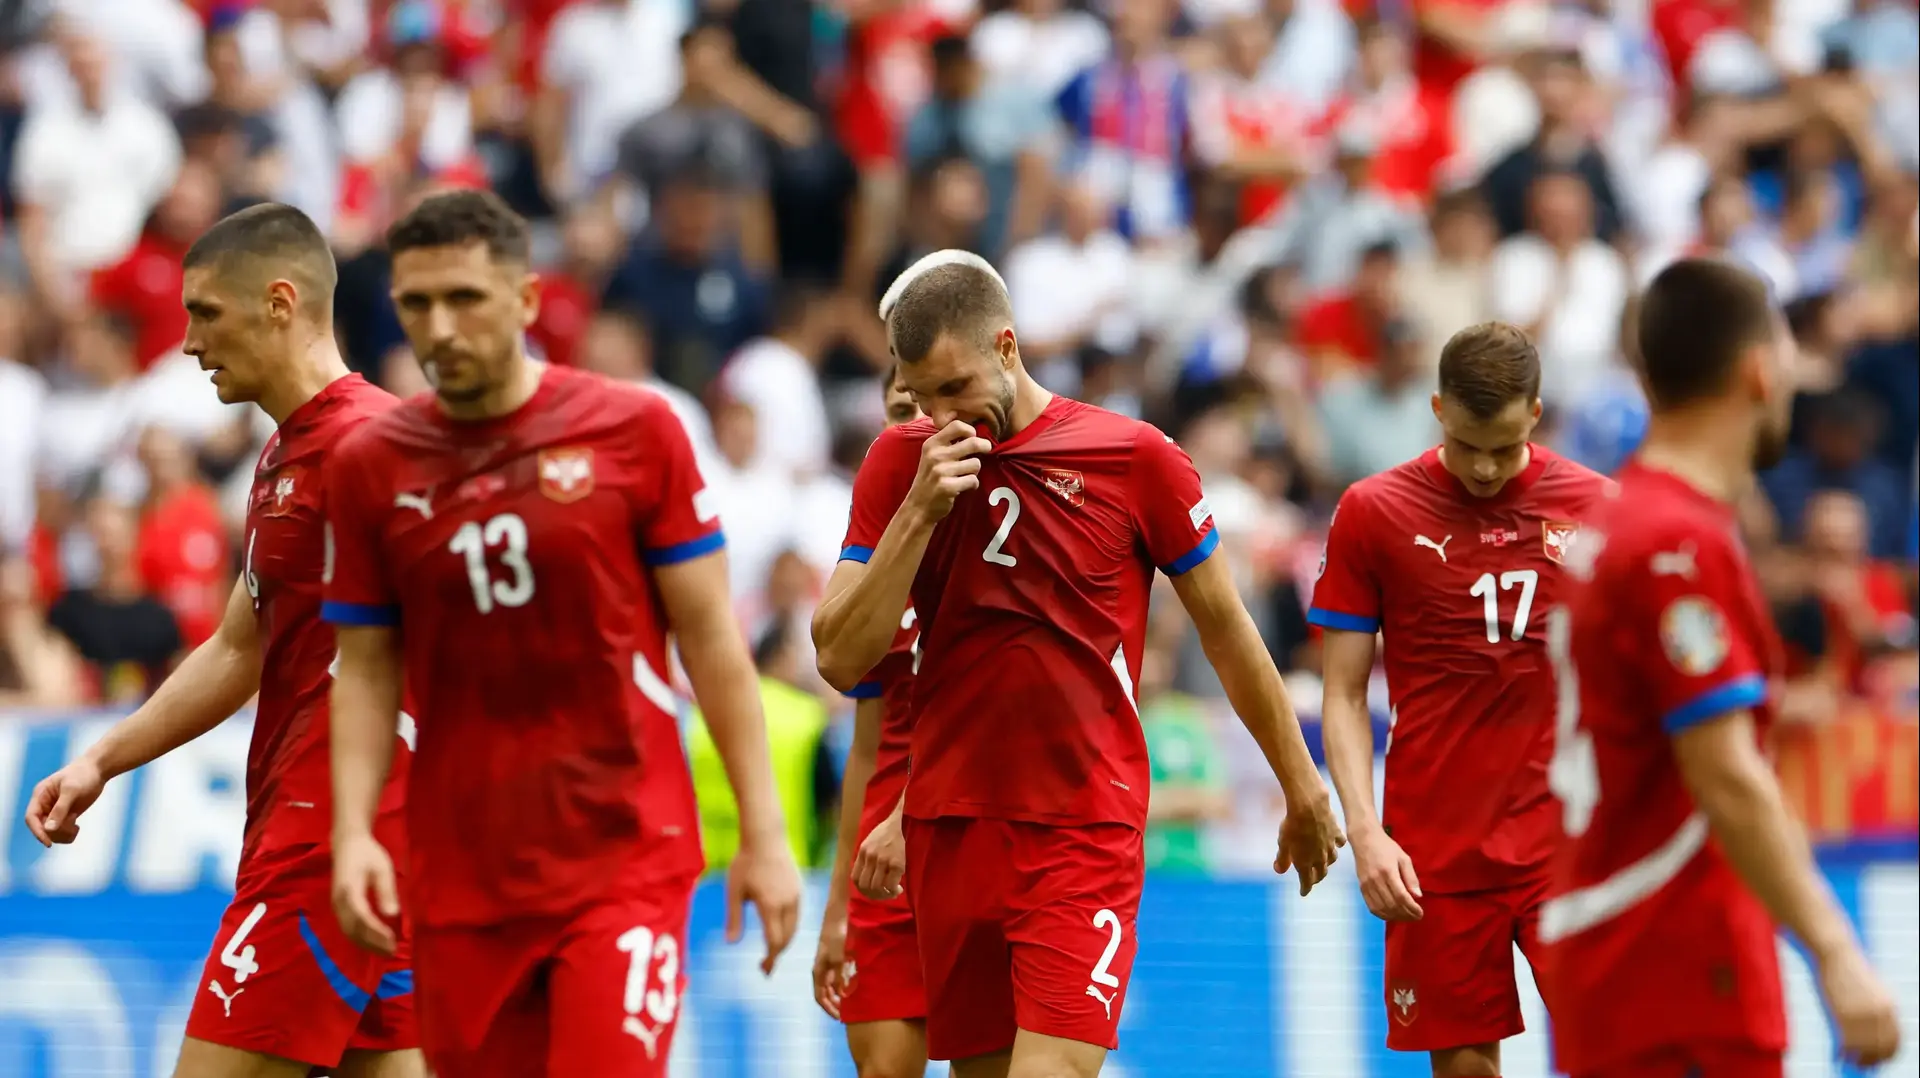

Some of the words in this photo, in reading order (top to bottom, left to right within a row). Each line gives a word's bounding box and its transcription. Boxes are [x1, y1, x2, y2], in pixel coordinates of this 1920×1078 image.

[449, 512, 535, 614] 13
[983, 487, 1020, 567] 2
[1470, 569, 1538, 643] 17
[221, 902, 267, 983] 4
[616, 925, 678, 1023] 13
[1091, 909, 1121, 988] 2
